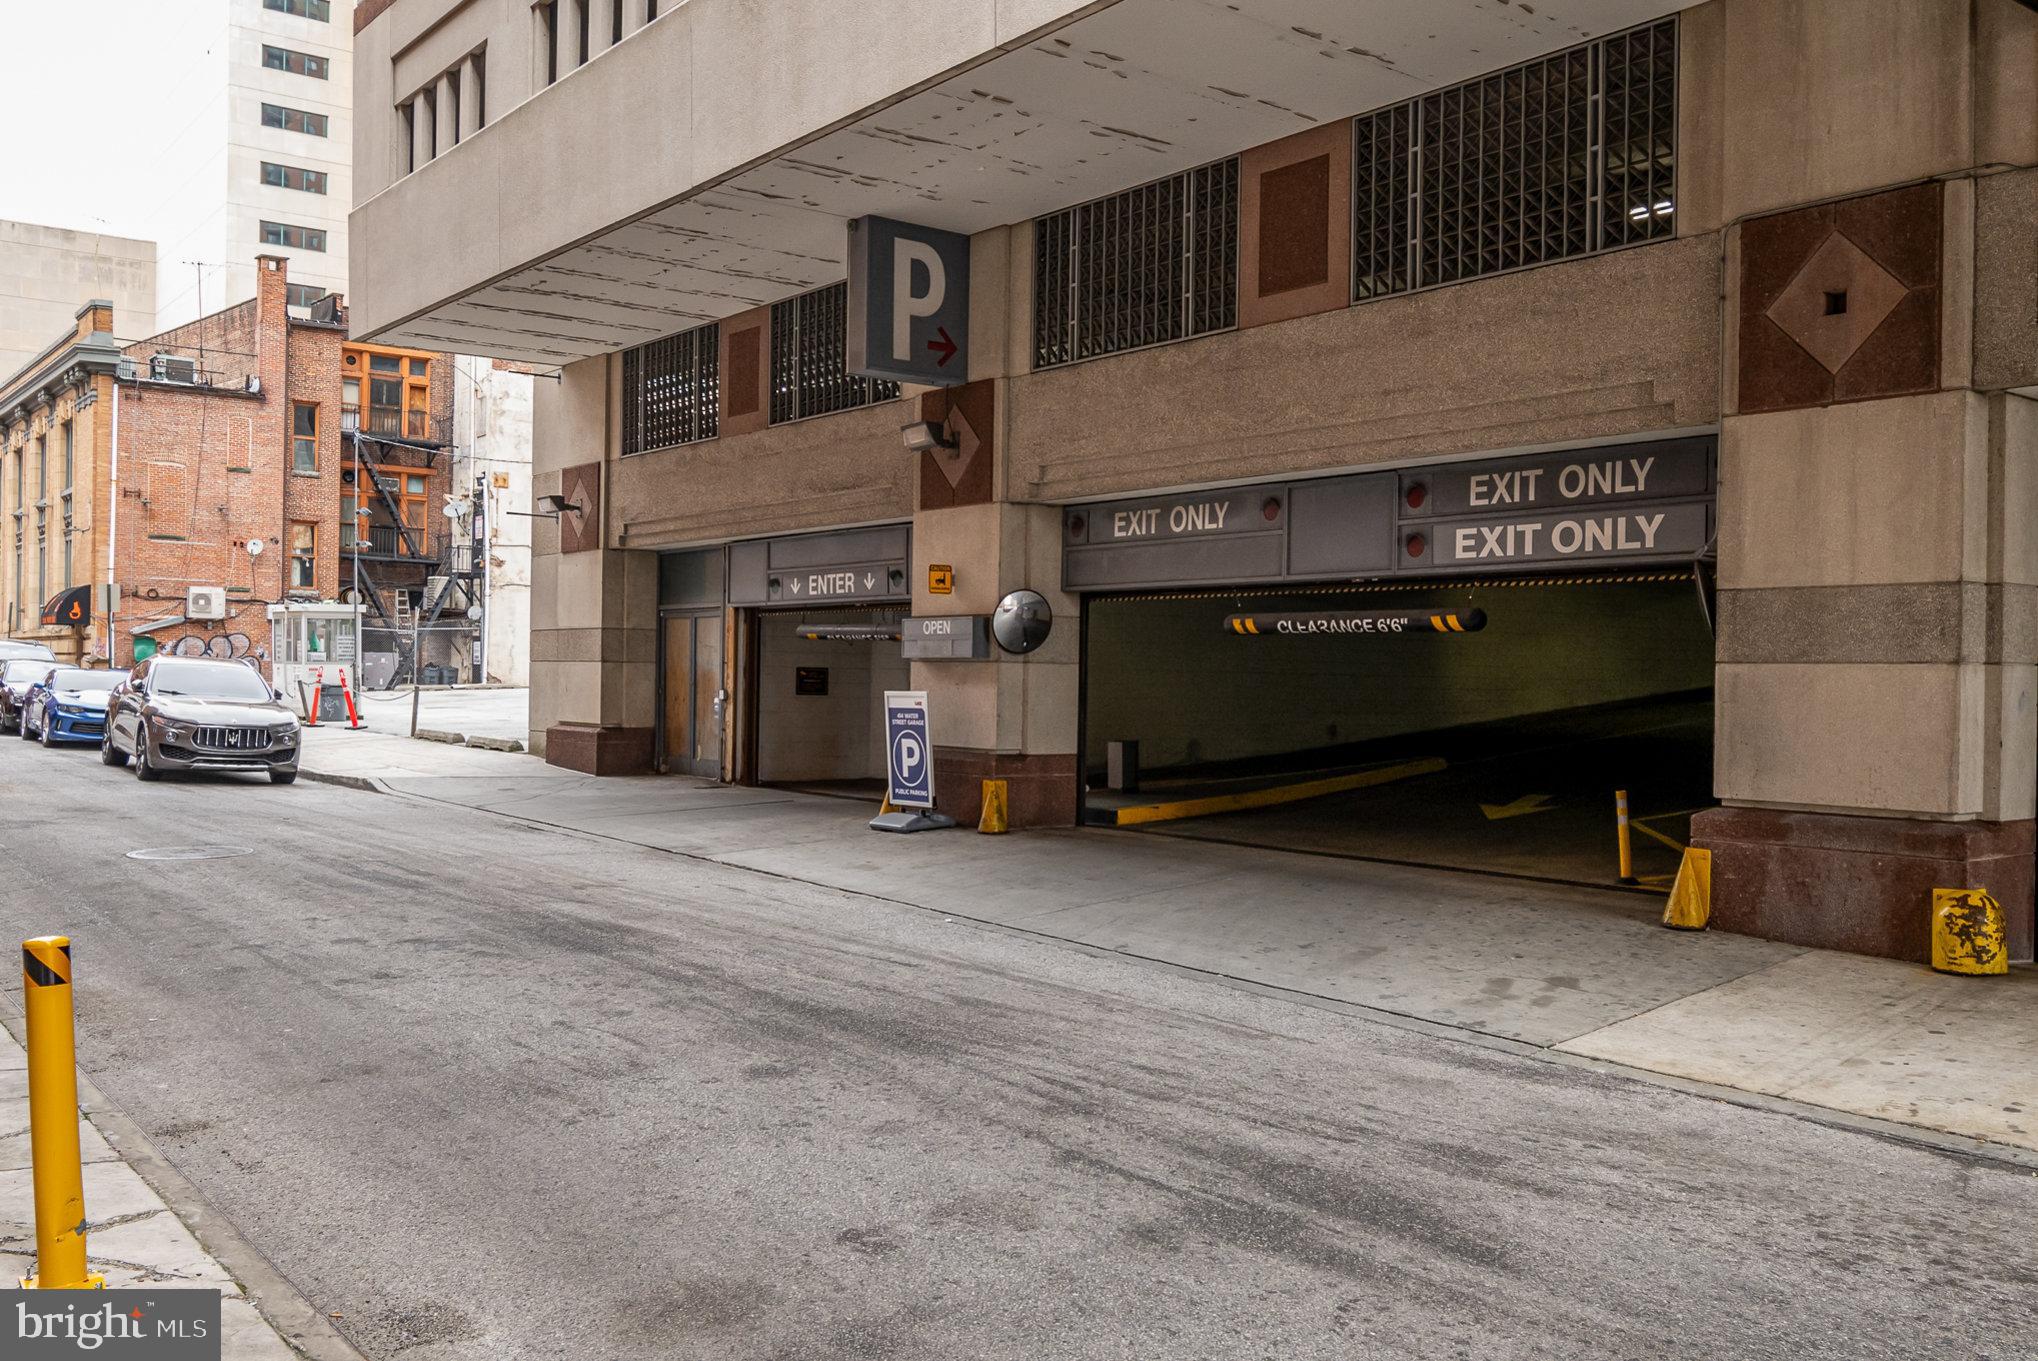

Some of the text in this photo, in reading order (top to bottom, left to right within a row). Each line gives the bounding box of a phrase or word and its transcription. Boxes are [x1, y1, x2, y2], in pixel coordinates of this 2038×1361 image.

[892, 236, 946, 362] P
[1468, 457, 1655, 508] EXIT ONLY
[1112, 501, 1229, 538] EXIT ONLY
[1453, 512, 1665, 560] EXIT ONLY
[808, 572, 855, 596] ENTER
[922, 620, 951, 636] OPEN
[1276, 618, 1374, 635] CLEARANCE
[900, 738, 920, 778] P
[910, 789, 928, 797] PARKING
